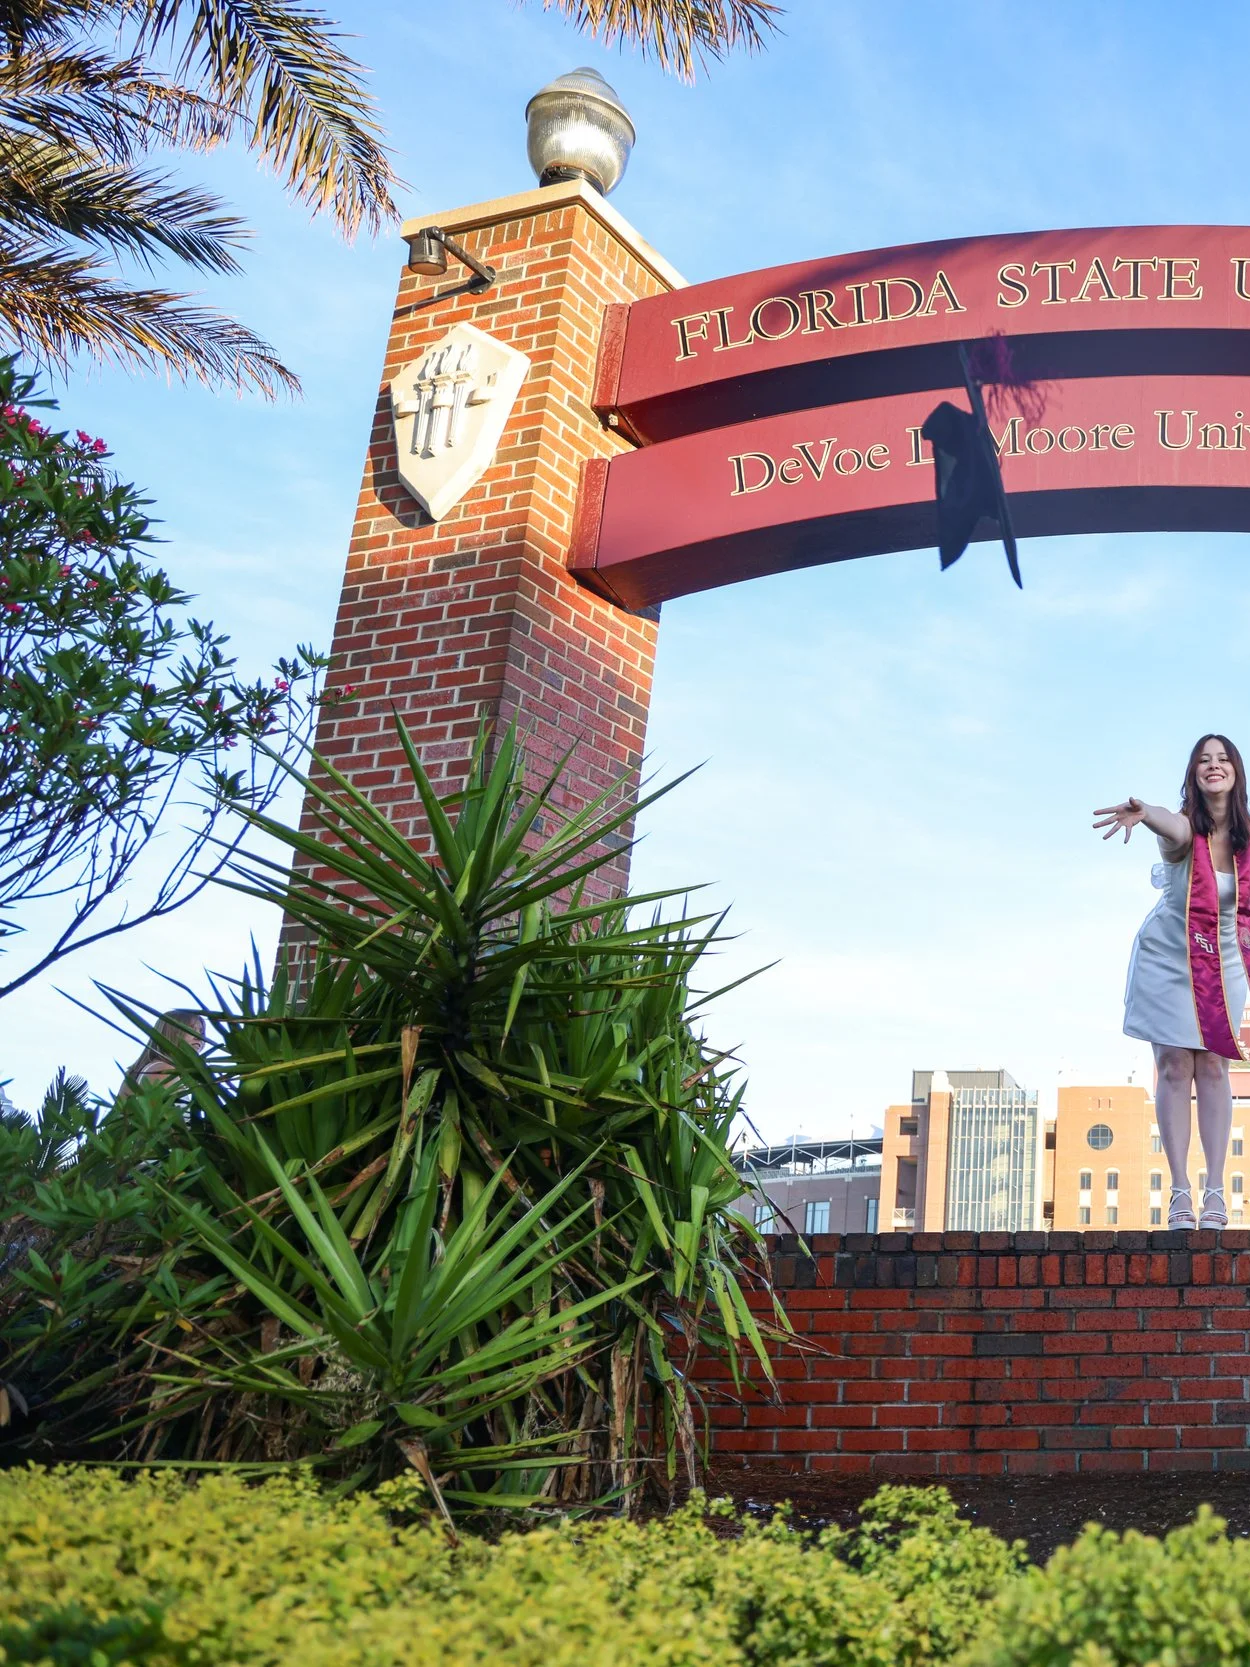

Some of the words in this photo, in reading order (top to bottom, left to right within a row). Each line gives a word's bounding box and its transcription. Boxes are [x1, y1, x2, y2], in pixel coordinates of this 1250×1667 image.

[670, 270, 968, 362] FLORIDA
[996, 256, 1203, 309] STATE
[728, 437, 891, 496] DeVoe
[987, 416, 1136, 457] Moore
[1194, 932, 1215, 953] FSU
